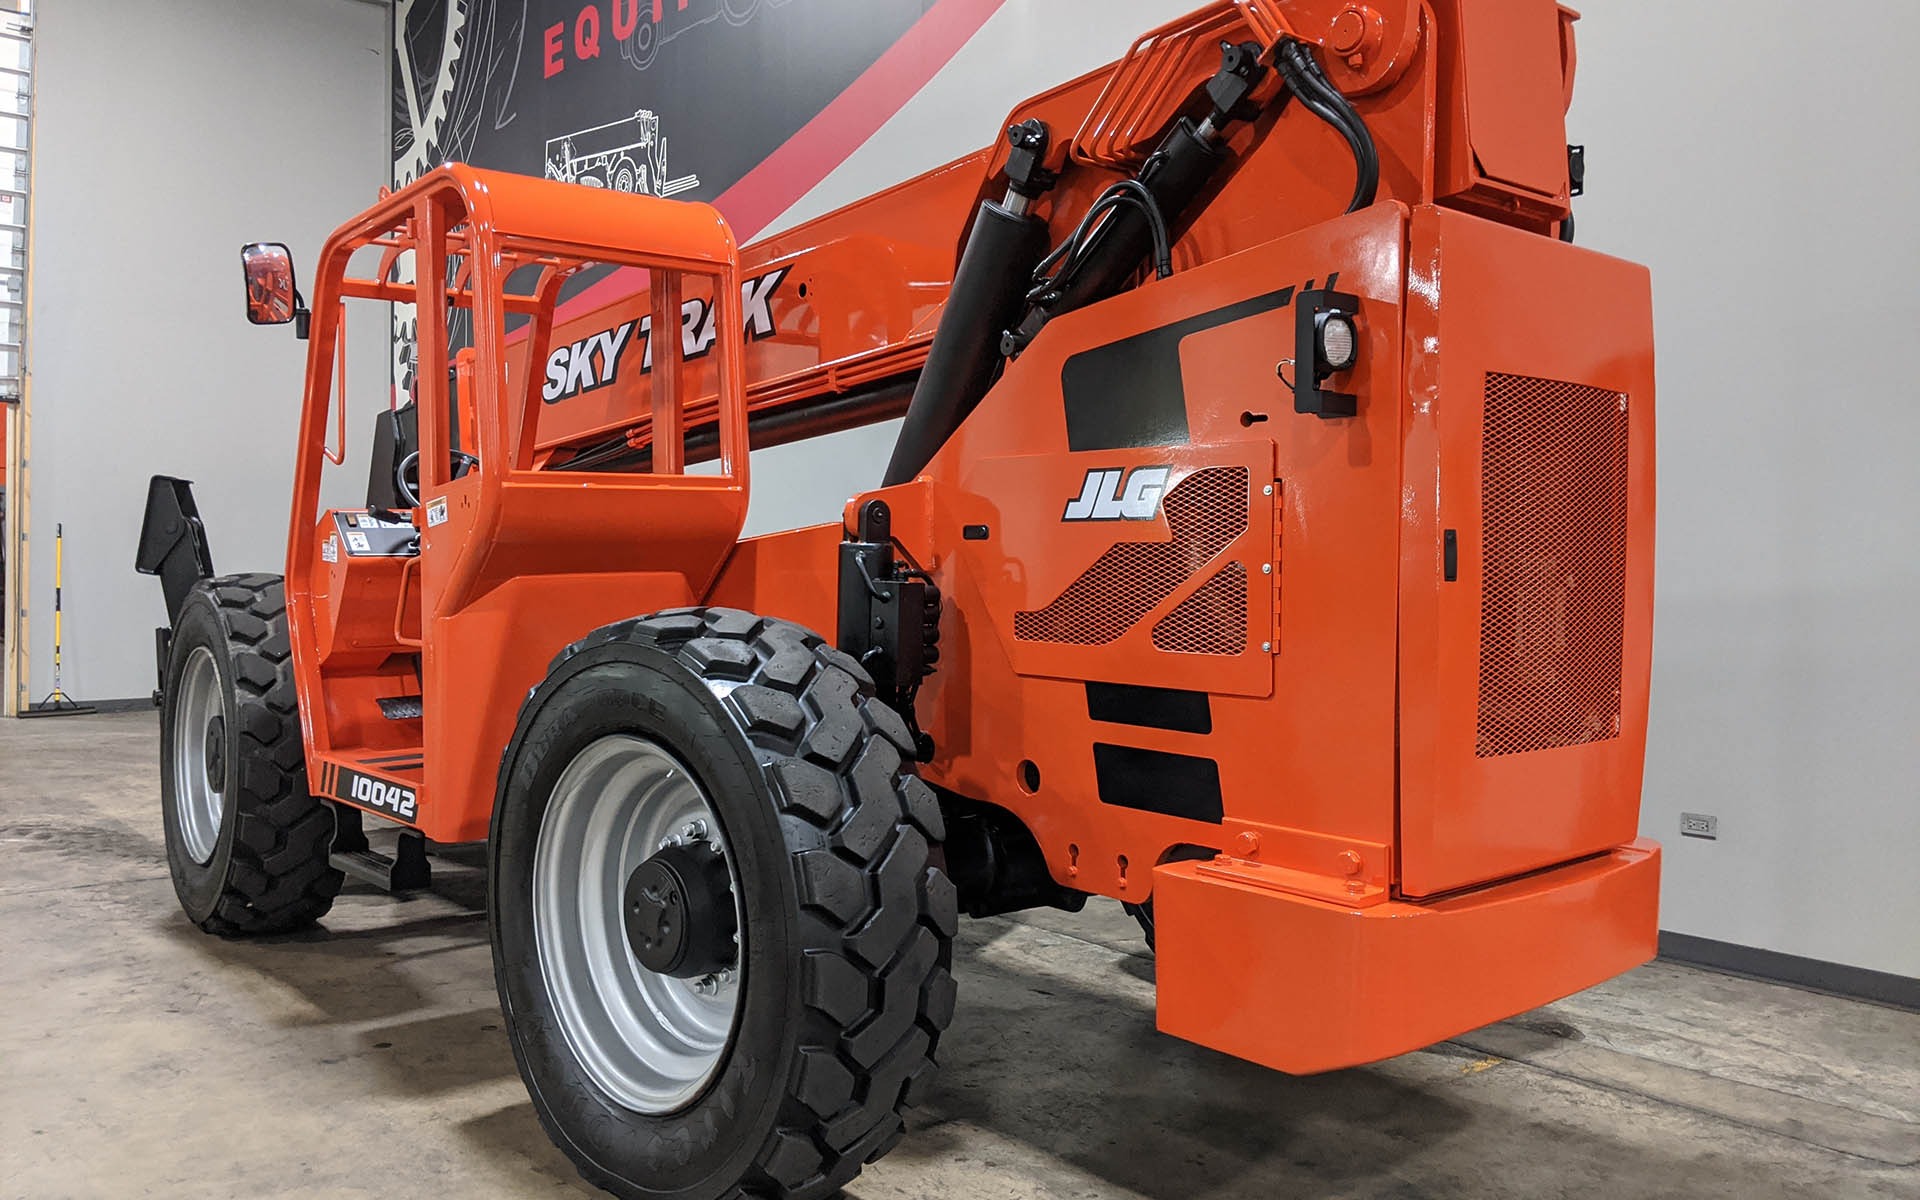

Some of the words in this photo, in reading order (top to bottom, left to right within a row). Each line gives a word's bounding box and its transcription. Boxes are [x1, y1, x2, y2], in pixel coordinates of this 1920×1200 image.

[543, 0, 689, 79] EQU
[541, 320, 638, 404] SKY
[1063, 466, 1172, 520] JLG
[350, 774, 416, 818] 10042
